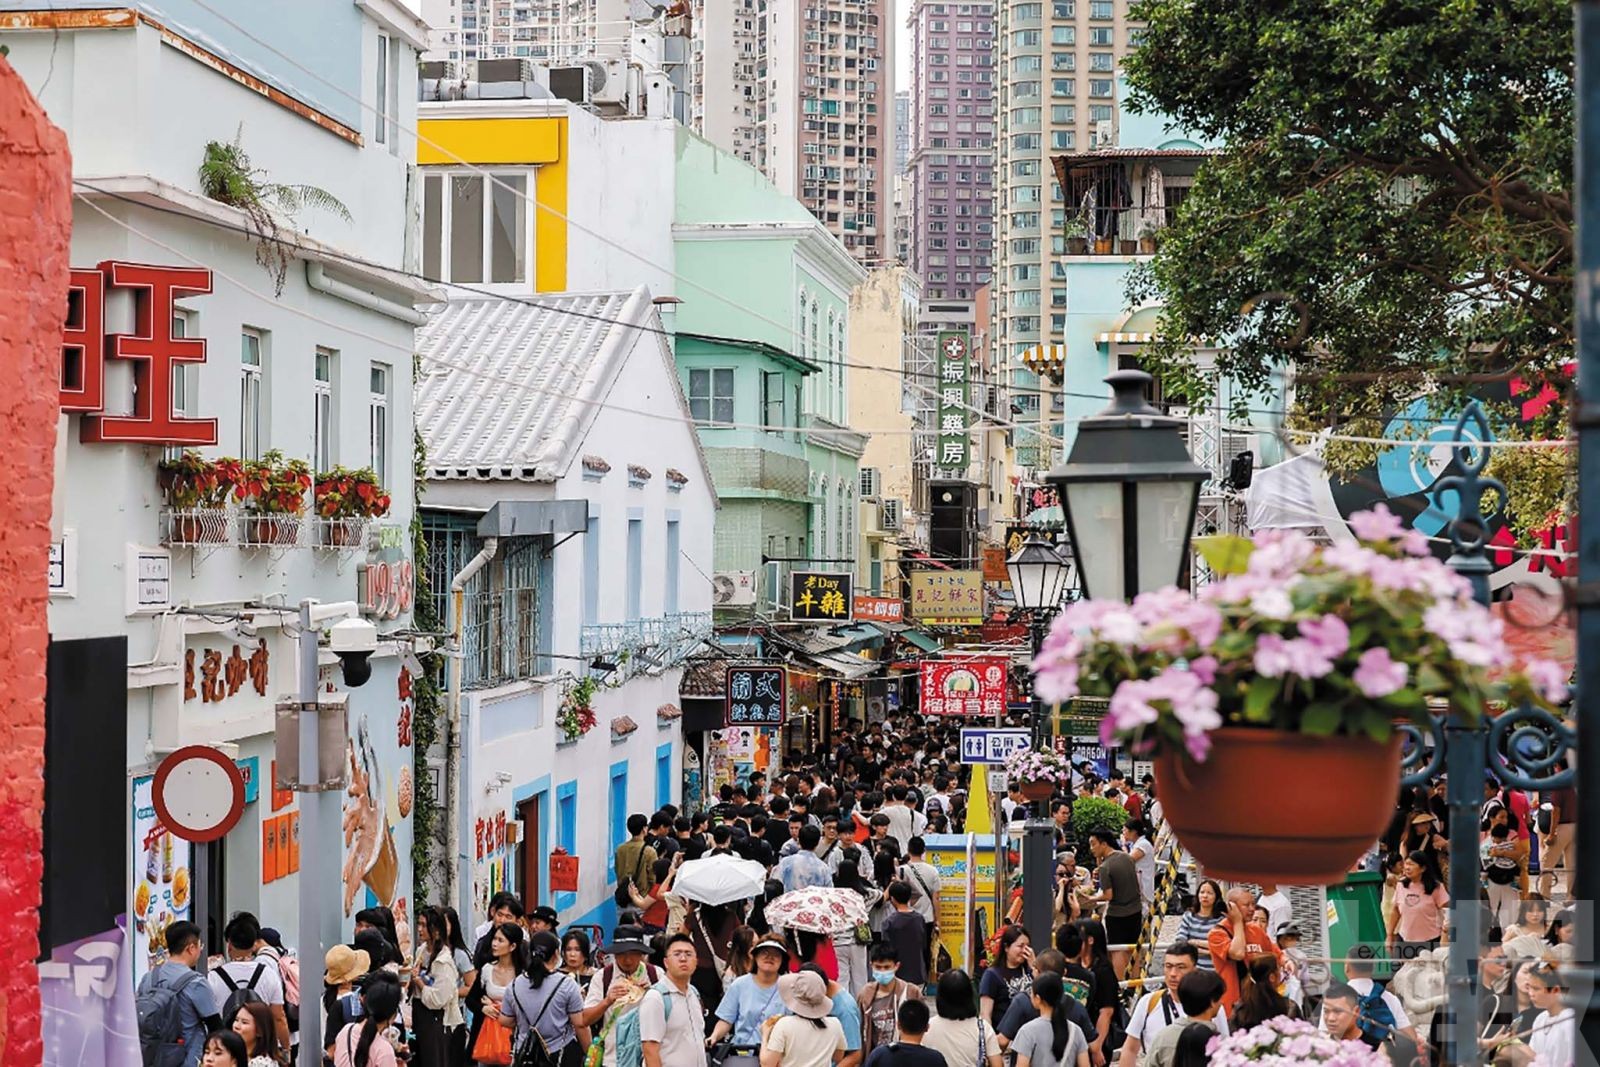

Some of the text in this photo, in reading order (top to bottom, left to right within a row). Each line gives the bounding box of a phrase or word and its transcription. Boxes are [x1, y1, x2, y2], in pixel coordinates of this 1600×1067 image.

[941, 360, 965, 464] 振興藥房
[366, 560, 412, 620] 1958
[795, 589, 847, 618] 牛雜
[476, 810, 506, 861] 官也街
